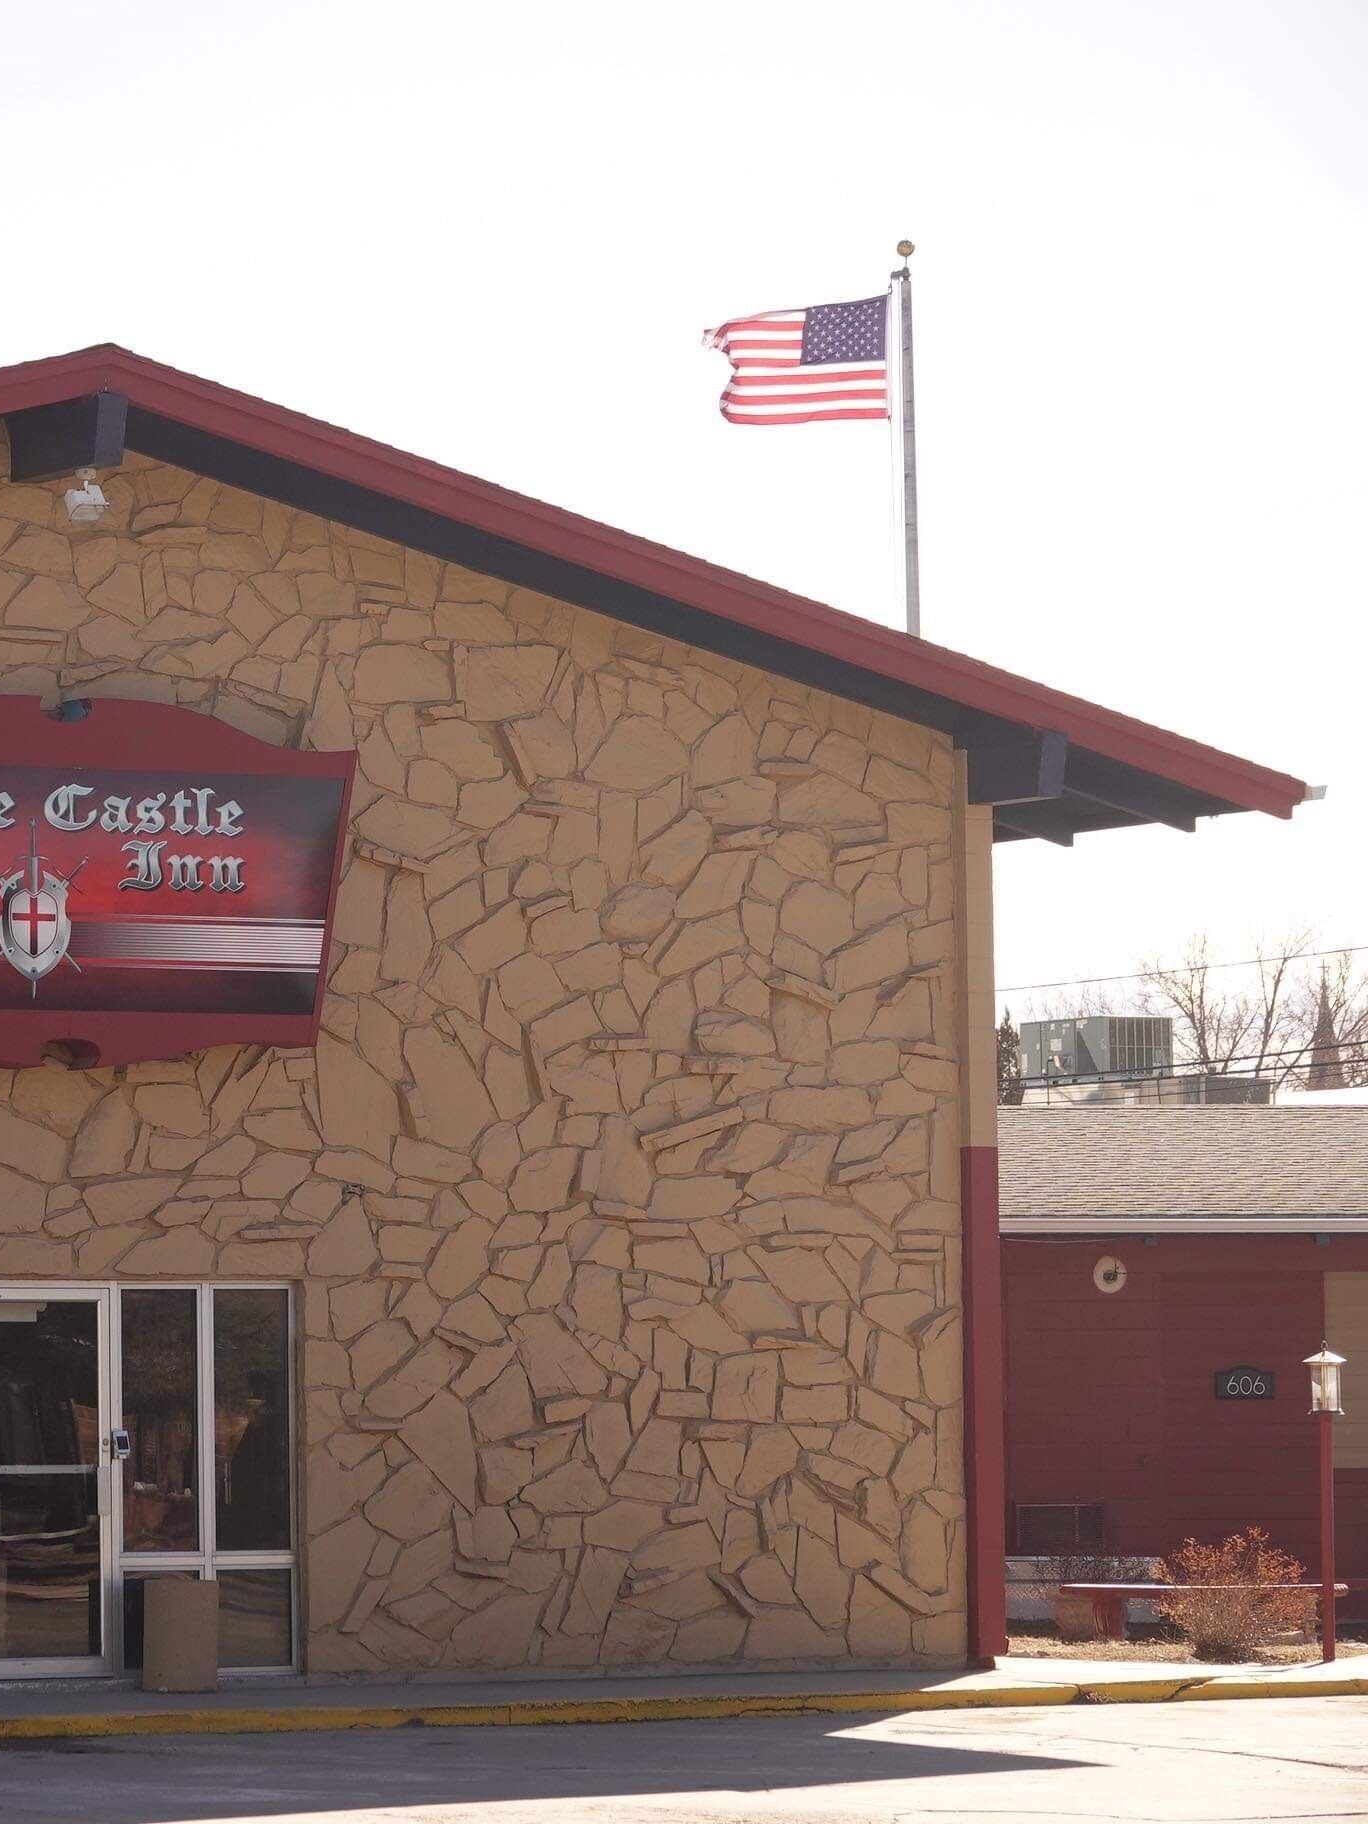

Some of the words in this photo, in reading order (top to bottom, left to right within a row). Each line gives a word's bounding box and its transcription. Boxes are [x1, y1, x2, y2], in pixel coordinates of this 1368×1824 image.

[43, 783, 245, 836] Castle
[117, 840, 247, 893] Inn
[1227, 1375, 1265, 1395] 606
